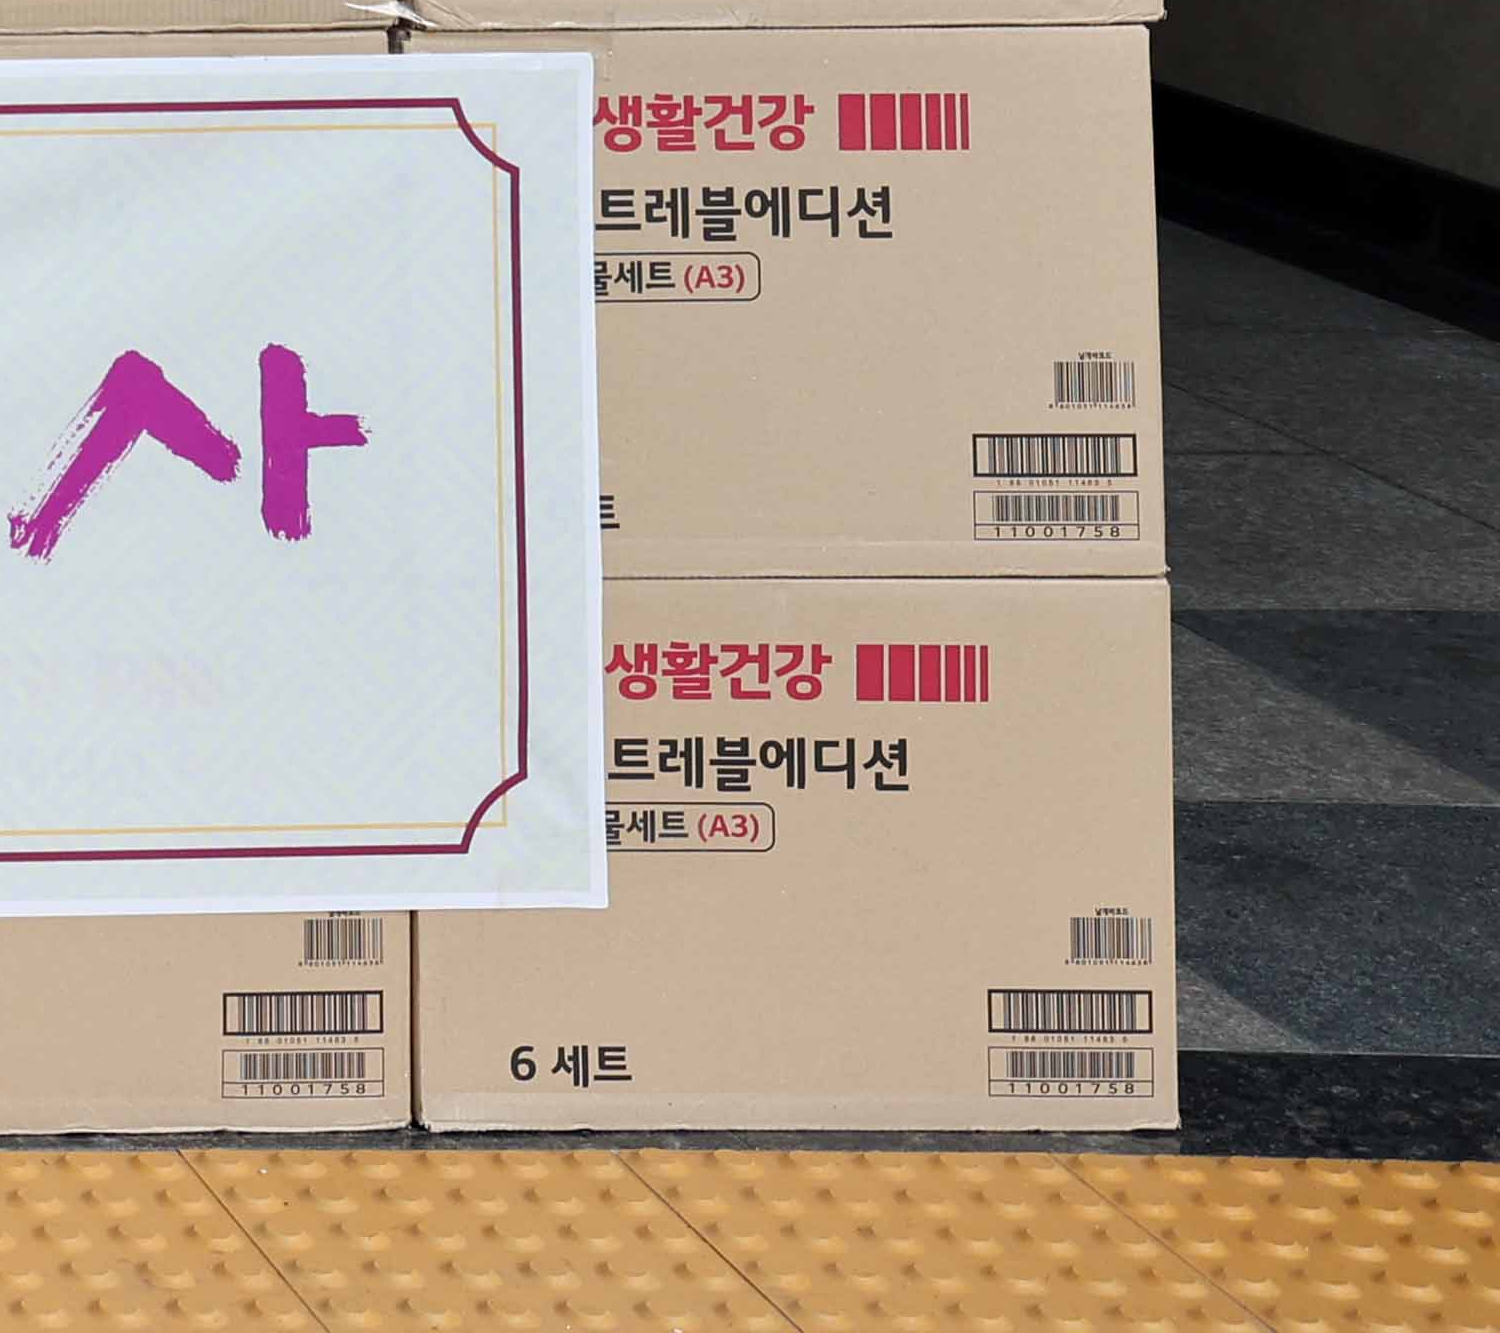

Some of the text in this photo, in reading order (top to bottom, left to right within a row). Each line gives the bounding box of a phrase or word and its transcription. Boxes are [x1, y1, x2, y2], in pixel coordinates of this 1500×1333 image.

[595, 187, 893, 242] 트레블에디션
[684, 264, 744, 293] (A3)
[994, 525, 1121, 539] 11001758
[608, 738, 909, 792] 트레블에디션
[698, 813, 759, 843] (A3)
[1008, 1081, 1135, 1096] 11001758
